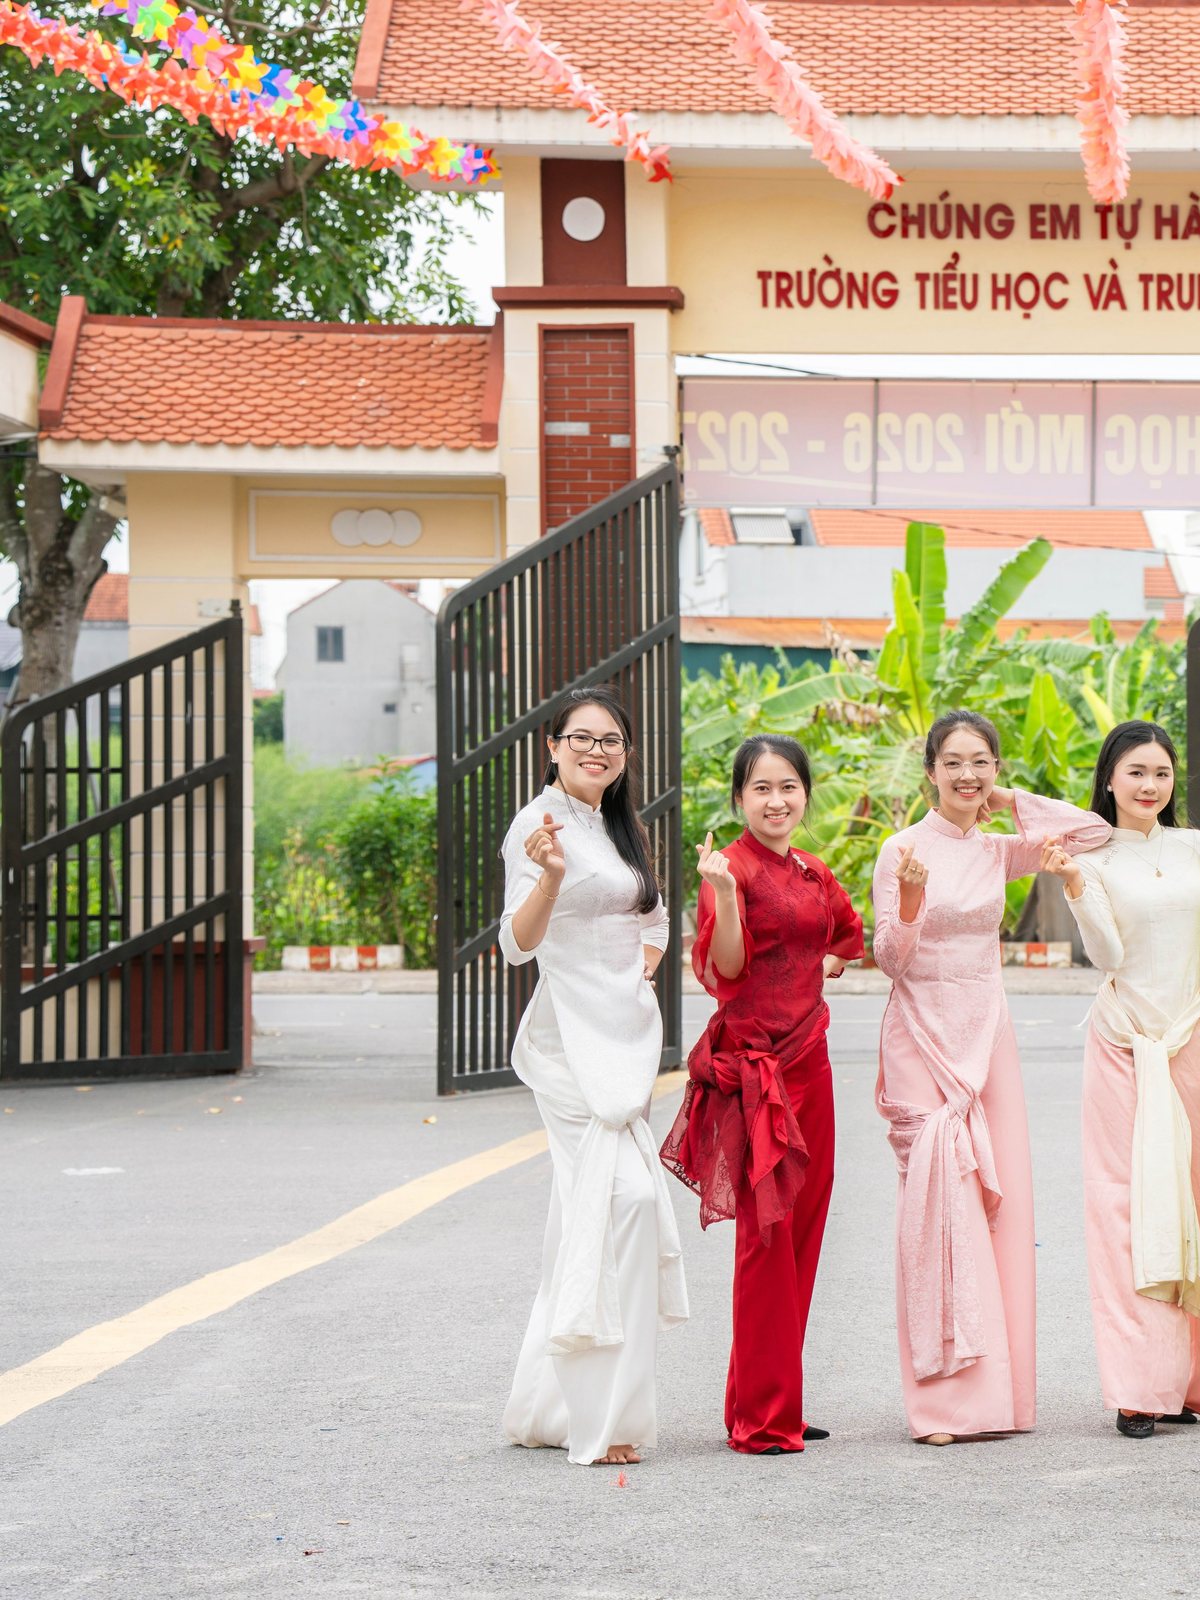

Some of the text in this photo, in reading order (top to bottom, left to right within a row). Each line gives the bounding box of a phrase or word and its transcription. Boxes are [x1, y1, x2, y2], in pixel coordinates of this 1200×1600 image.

[867, 190, 1015, 240] CHÚNG
[1029, 203, 1081, 240] EM
[1094, 198, 1143, 250] TỰ
[757, 254, 899, 309] TRƯỜNG
[915, 251, 979, 310] TIỂU
[991, 271, 1069, 319] HỌC
[1083, 258, 1127, 310] VÀ
